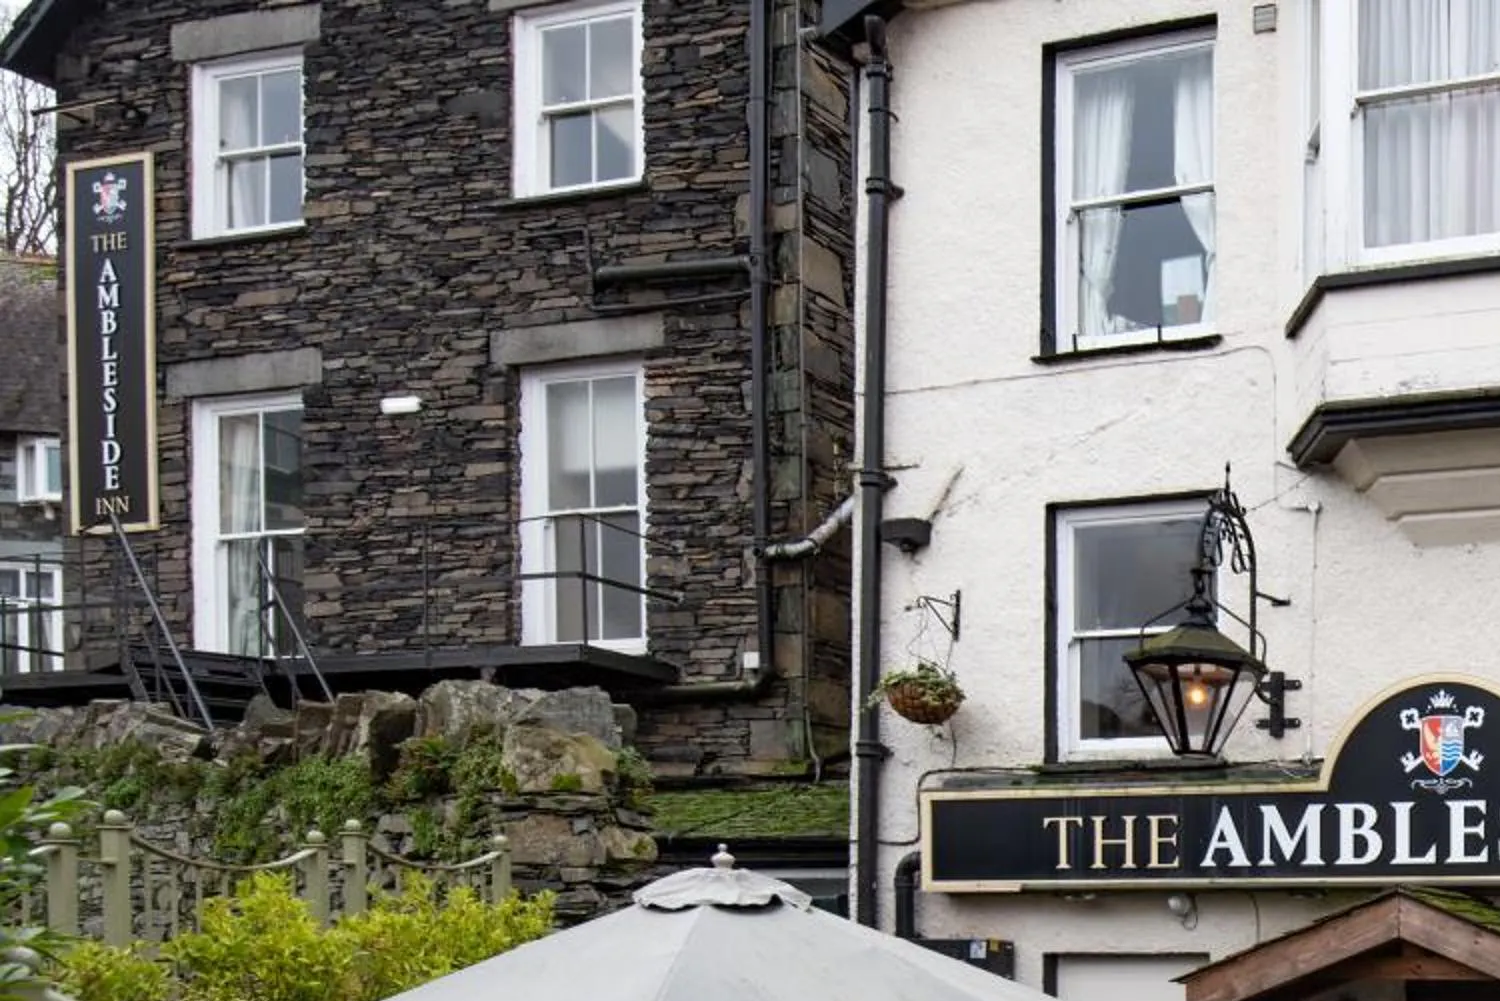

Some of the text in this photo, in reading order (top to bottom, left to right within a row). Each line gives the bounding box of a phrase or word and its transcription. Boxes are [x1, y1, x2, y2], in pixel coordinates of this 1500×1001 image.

[91, 232, 128, 252] THE
[97, 258, 121, 490] AMBLESIDE
[96, 496, 129, 515] INN
[1043, 815, 1181, 870] THE
